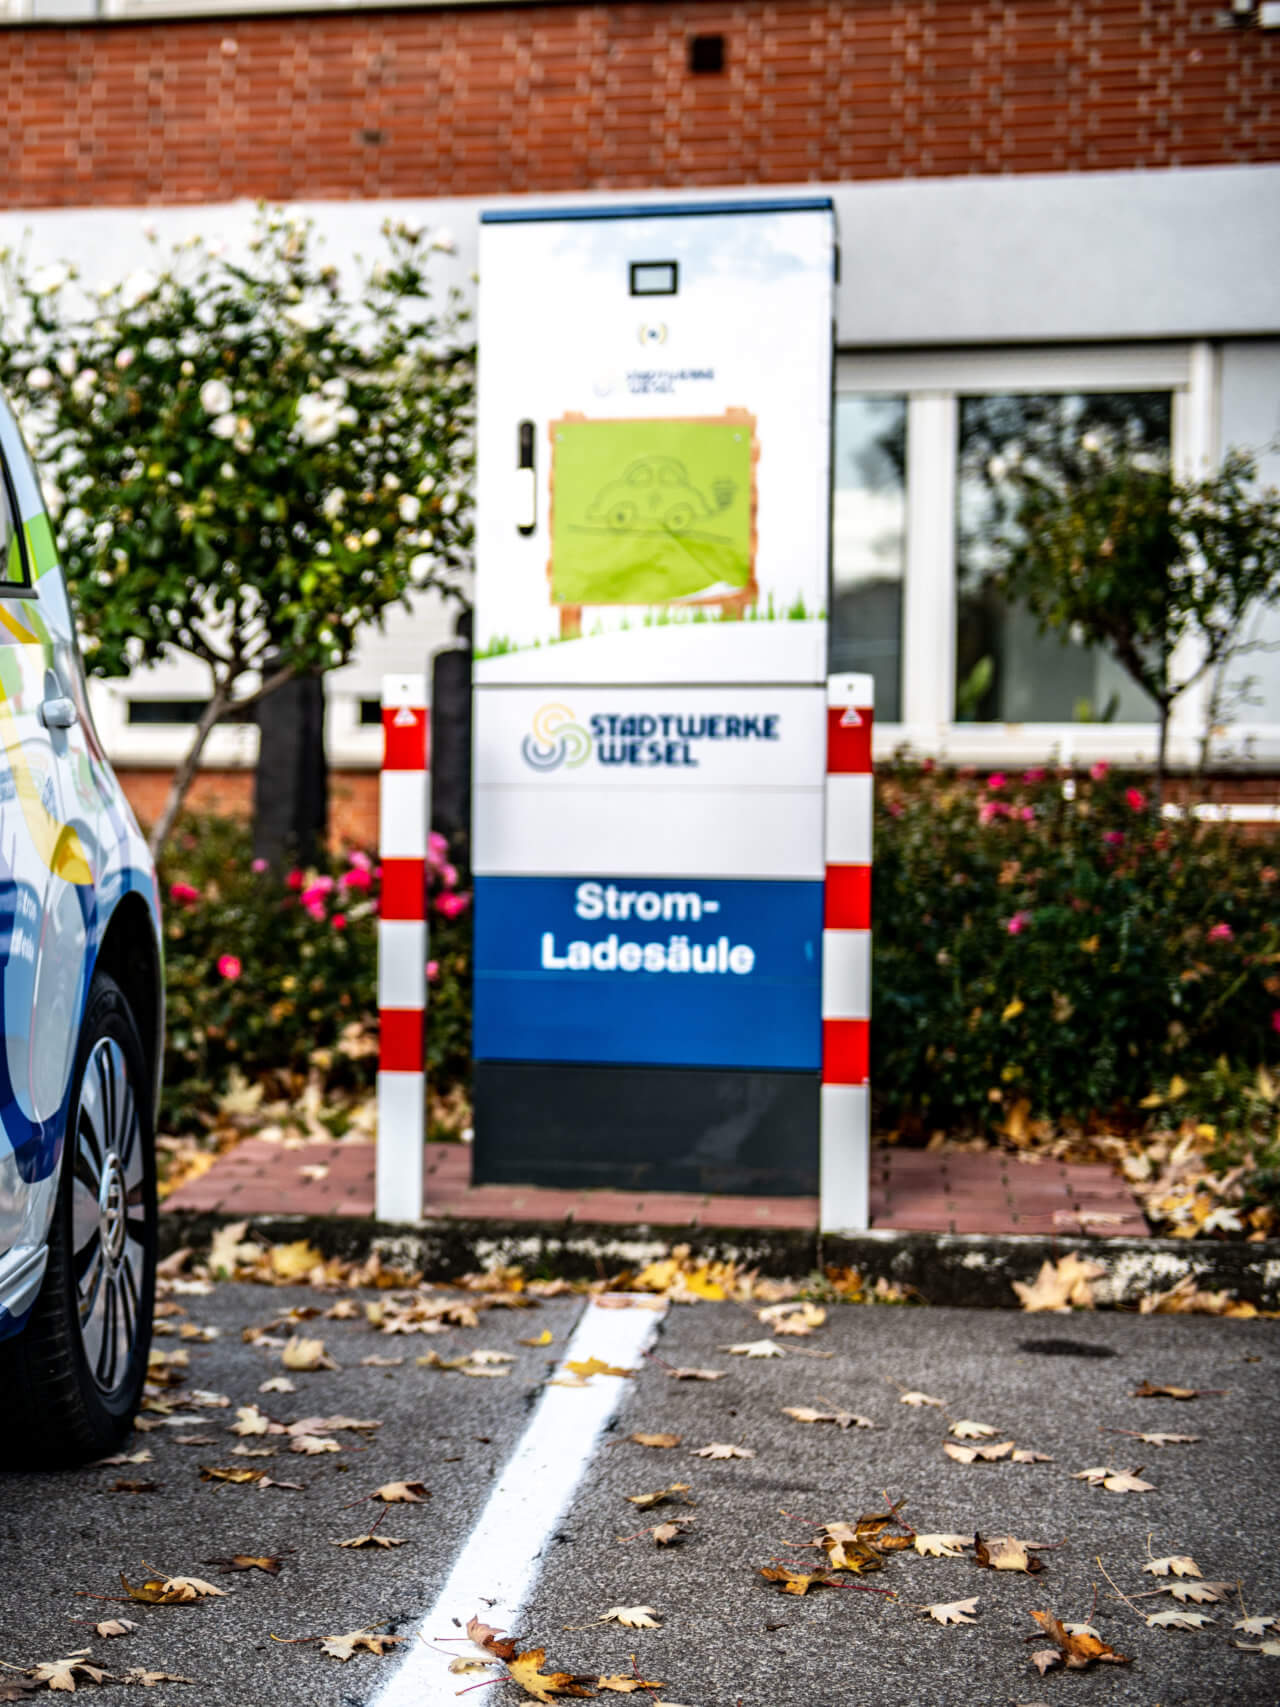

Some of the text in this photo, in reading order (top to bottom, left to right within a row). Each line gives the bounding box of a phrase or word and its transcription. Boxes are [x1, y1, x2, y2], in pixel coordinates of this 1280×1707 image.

[589, 713, 780, 740] STADTWERKE
[597, 740, 699, 767] WESEL
[575, 881, 720, 922] Strom-
[540, 931, 756, 975] Ladesäule
